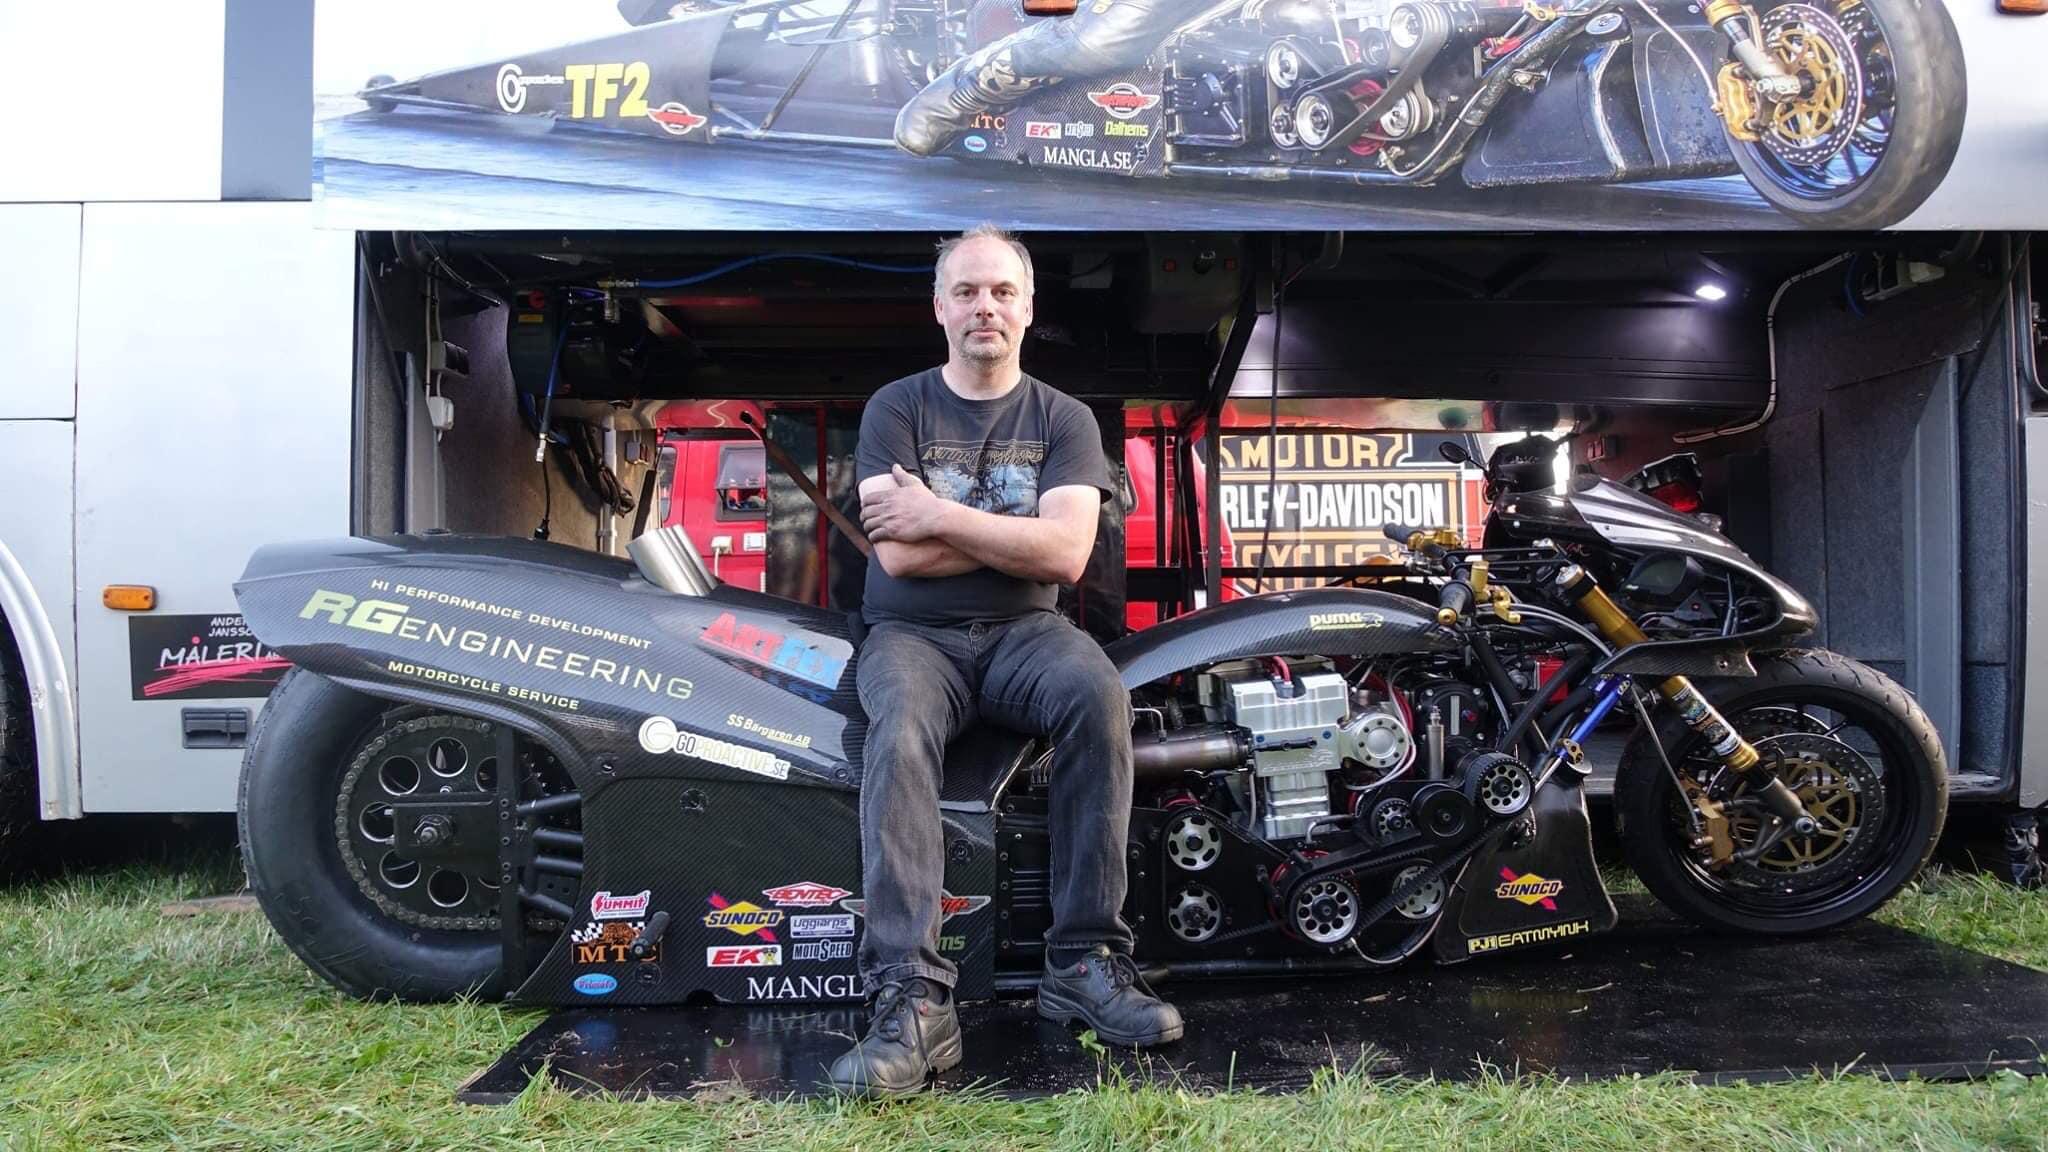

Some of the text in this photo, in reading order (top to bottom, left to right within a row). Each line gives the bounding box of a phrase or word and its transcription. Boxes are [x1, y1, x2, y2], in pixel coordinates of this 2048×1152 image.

[565, 61, 651, 119] TF2
[1043, 145, 1132, 169] MANGLA.SE
[1241, 434, 1380, 468] MOTOR
[371, 579, 652, 650] HI PERFORMANCE DEVELOPMENT
[399, 617, 694, 700] ENGINEERING
[388, 661, 579, 710] MOTORCYCLE SERVICE
[1499, 882, 1560, 896] SUNOCO
[709, 911, 780, 925] SUNOCO
[712, 949, 764, 965] EK
[793, 940, 852, 960] MOTOSPEED
